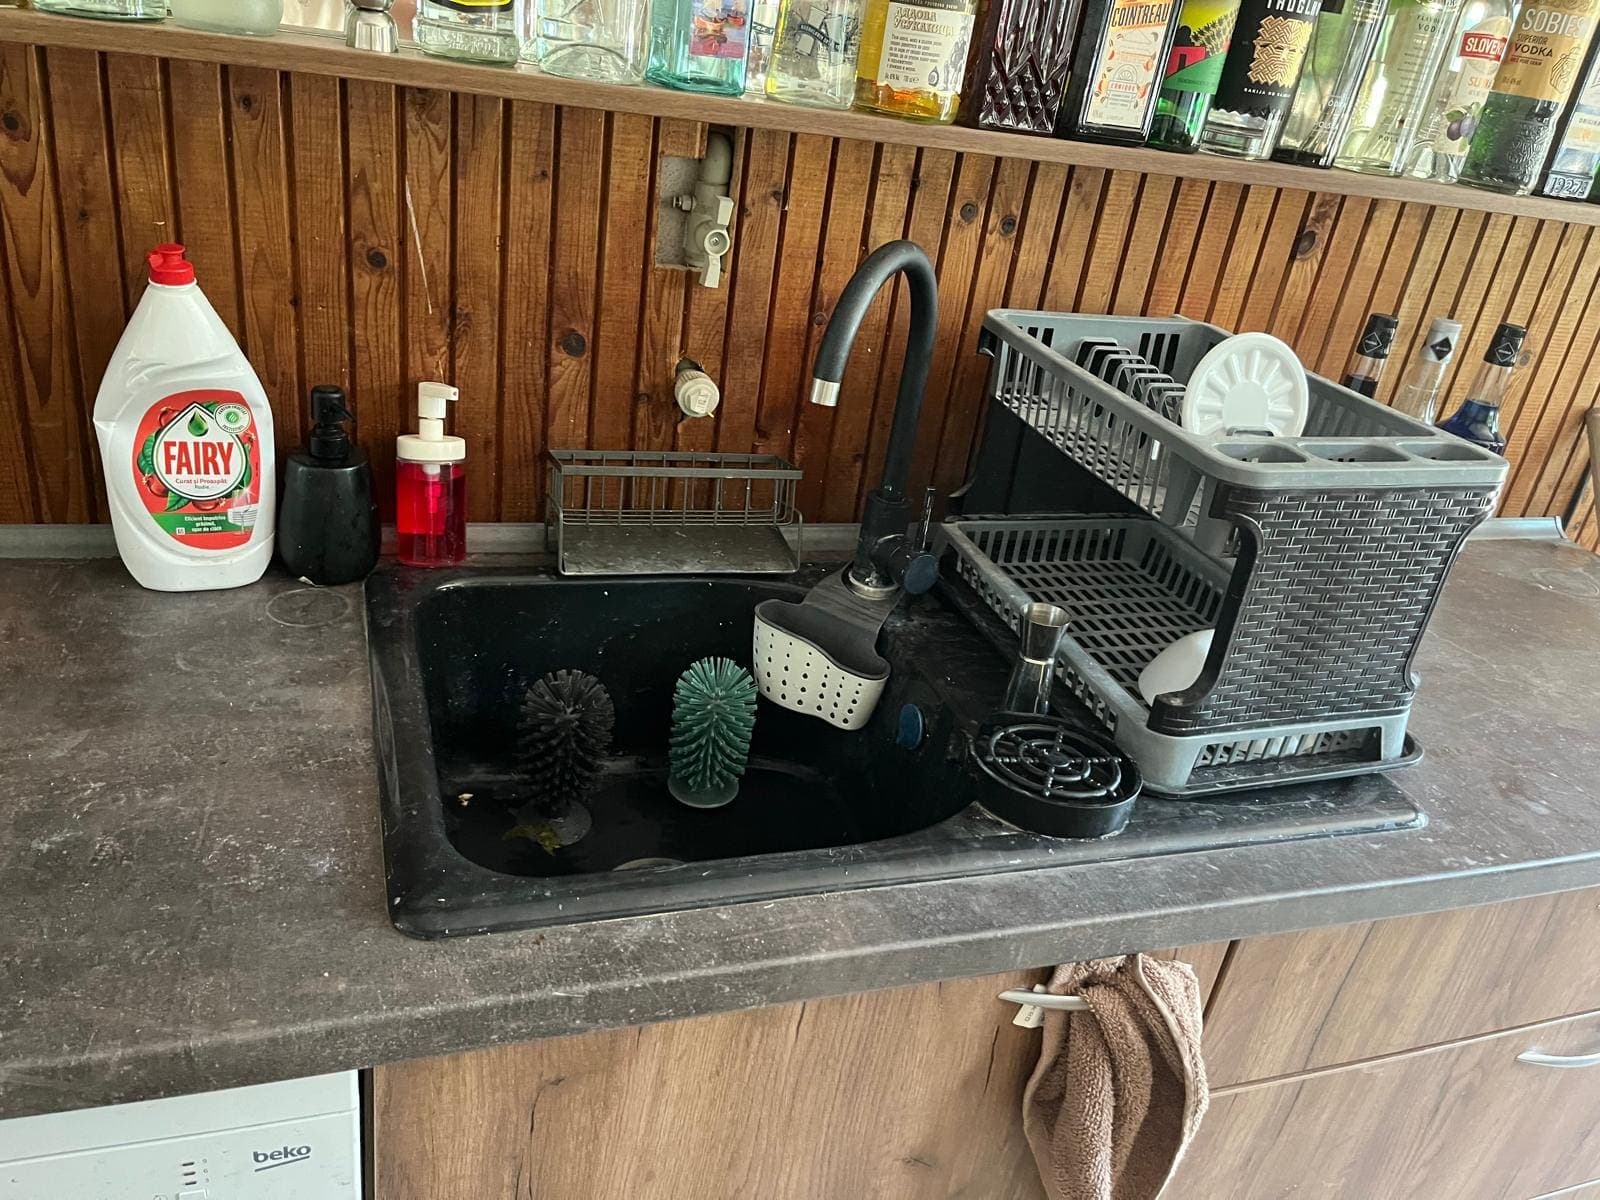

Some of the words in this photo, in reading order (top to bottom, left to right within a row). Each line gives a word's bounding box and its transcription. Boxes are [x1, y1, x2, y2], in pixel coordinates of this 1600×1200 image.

[1111, 4, 1171, 27] COINTREAU
[1516, 33, 1548, 45] SUPERIOR
[1514, 43, 1553, 57] VODKA
[164, 441, 234, 475] FAIRY
[253, 1145, 312, 1163] beko
